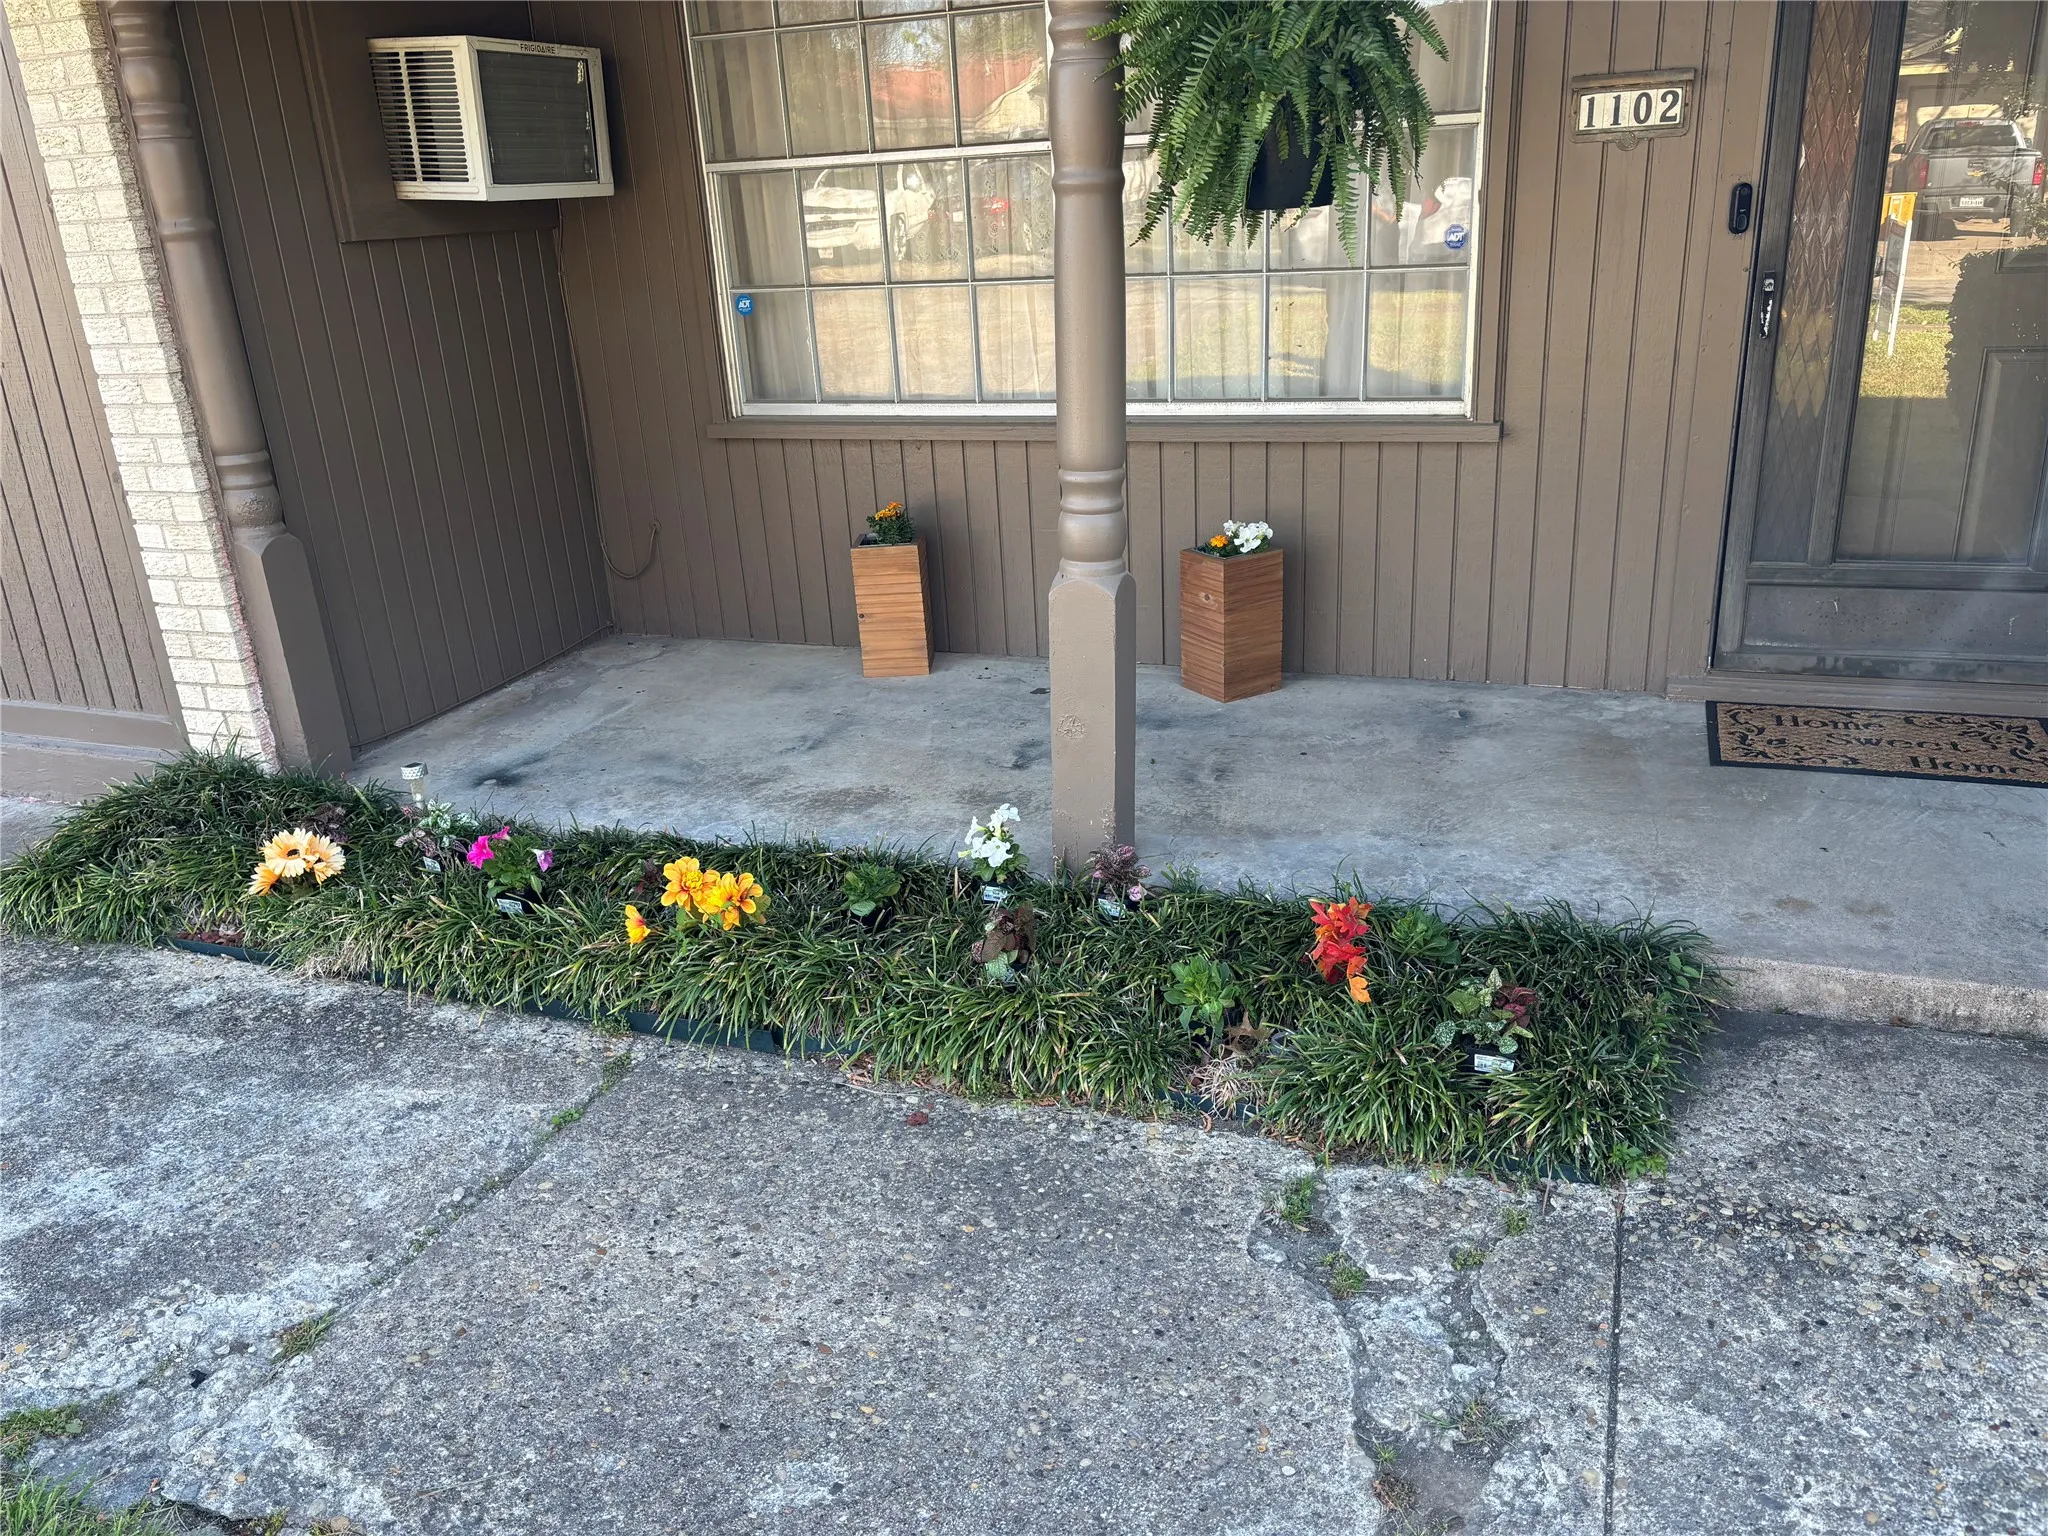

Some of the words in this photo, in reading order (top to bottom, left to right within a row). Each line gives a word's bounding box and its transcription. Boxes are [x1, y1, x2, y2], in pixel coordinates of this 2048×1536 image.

[520, 43, 556, 55] FRIGIDAIRE
[1584, 90, 1680, 128] 1102
[1447, 232, 1465, 242] ADT
[1774, 713, 1887, 731] Home
[1826, 733, 1970, 753] Sweet
[1908, 755, 2036, 776] Home
